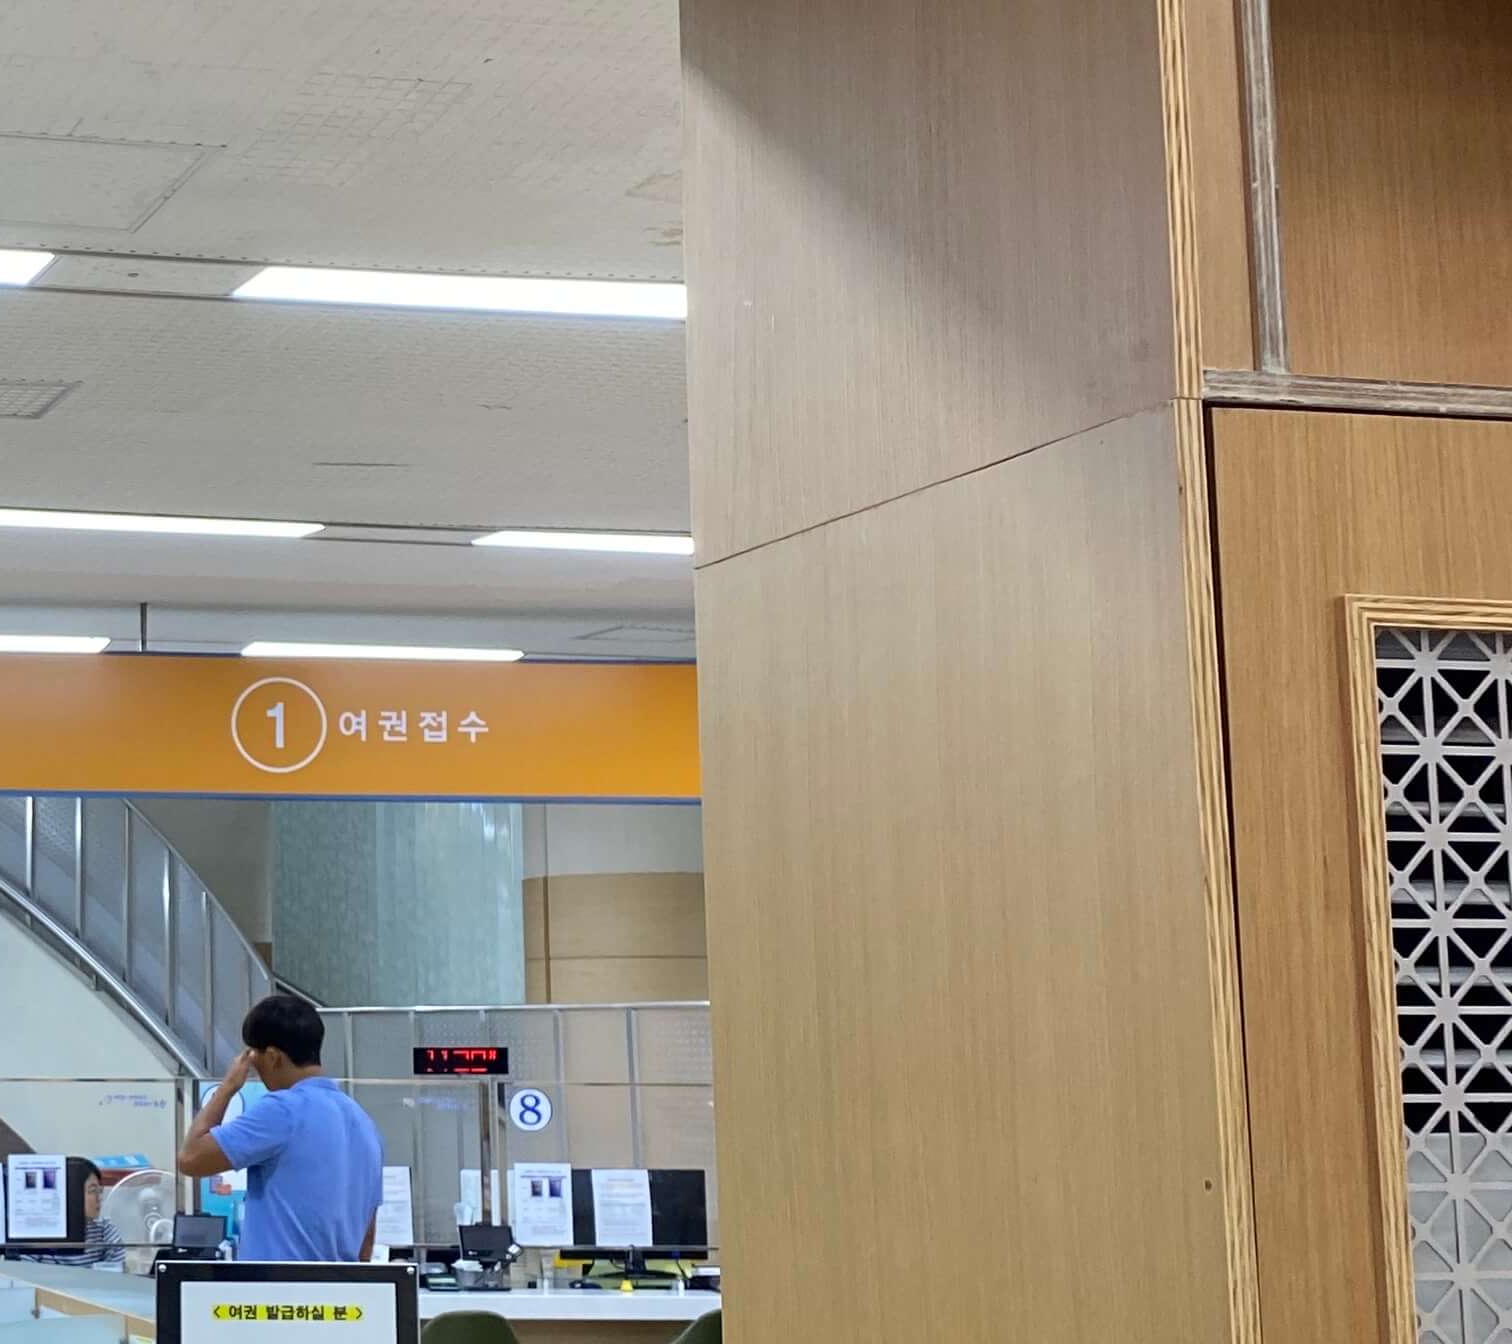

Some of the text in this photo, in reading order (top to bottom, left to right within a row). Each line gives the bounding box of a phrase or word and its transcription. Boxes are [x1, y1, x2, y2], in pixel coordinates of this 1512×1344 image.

[266, 702, 489, 749] 1 여권접수
[518, 1093, 542, 1126] 8
[228, 1305, 257, 1320] 여권
[266, 1305, 325, 1321] 발급하실
[333, 1306, 348, 1321] 분
